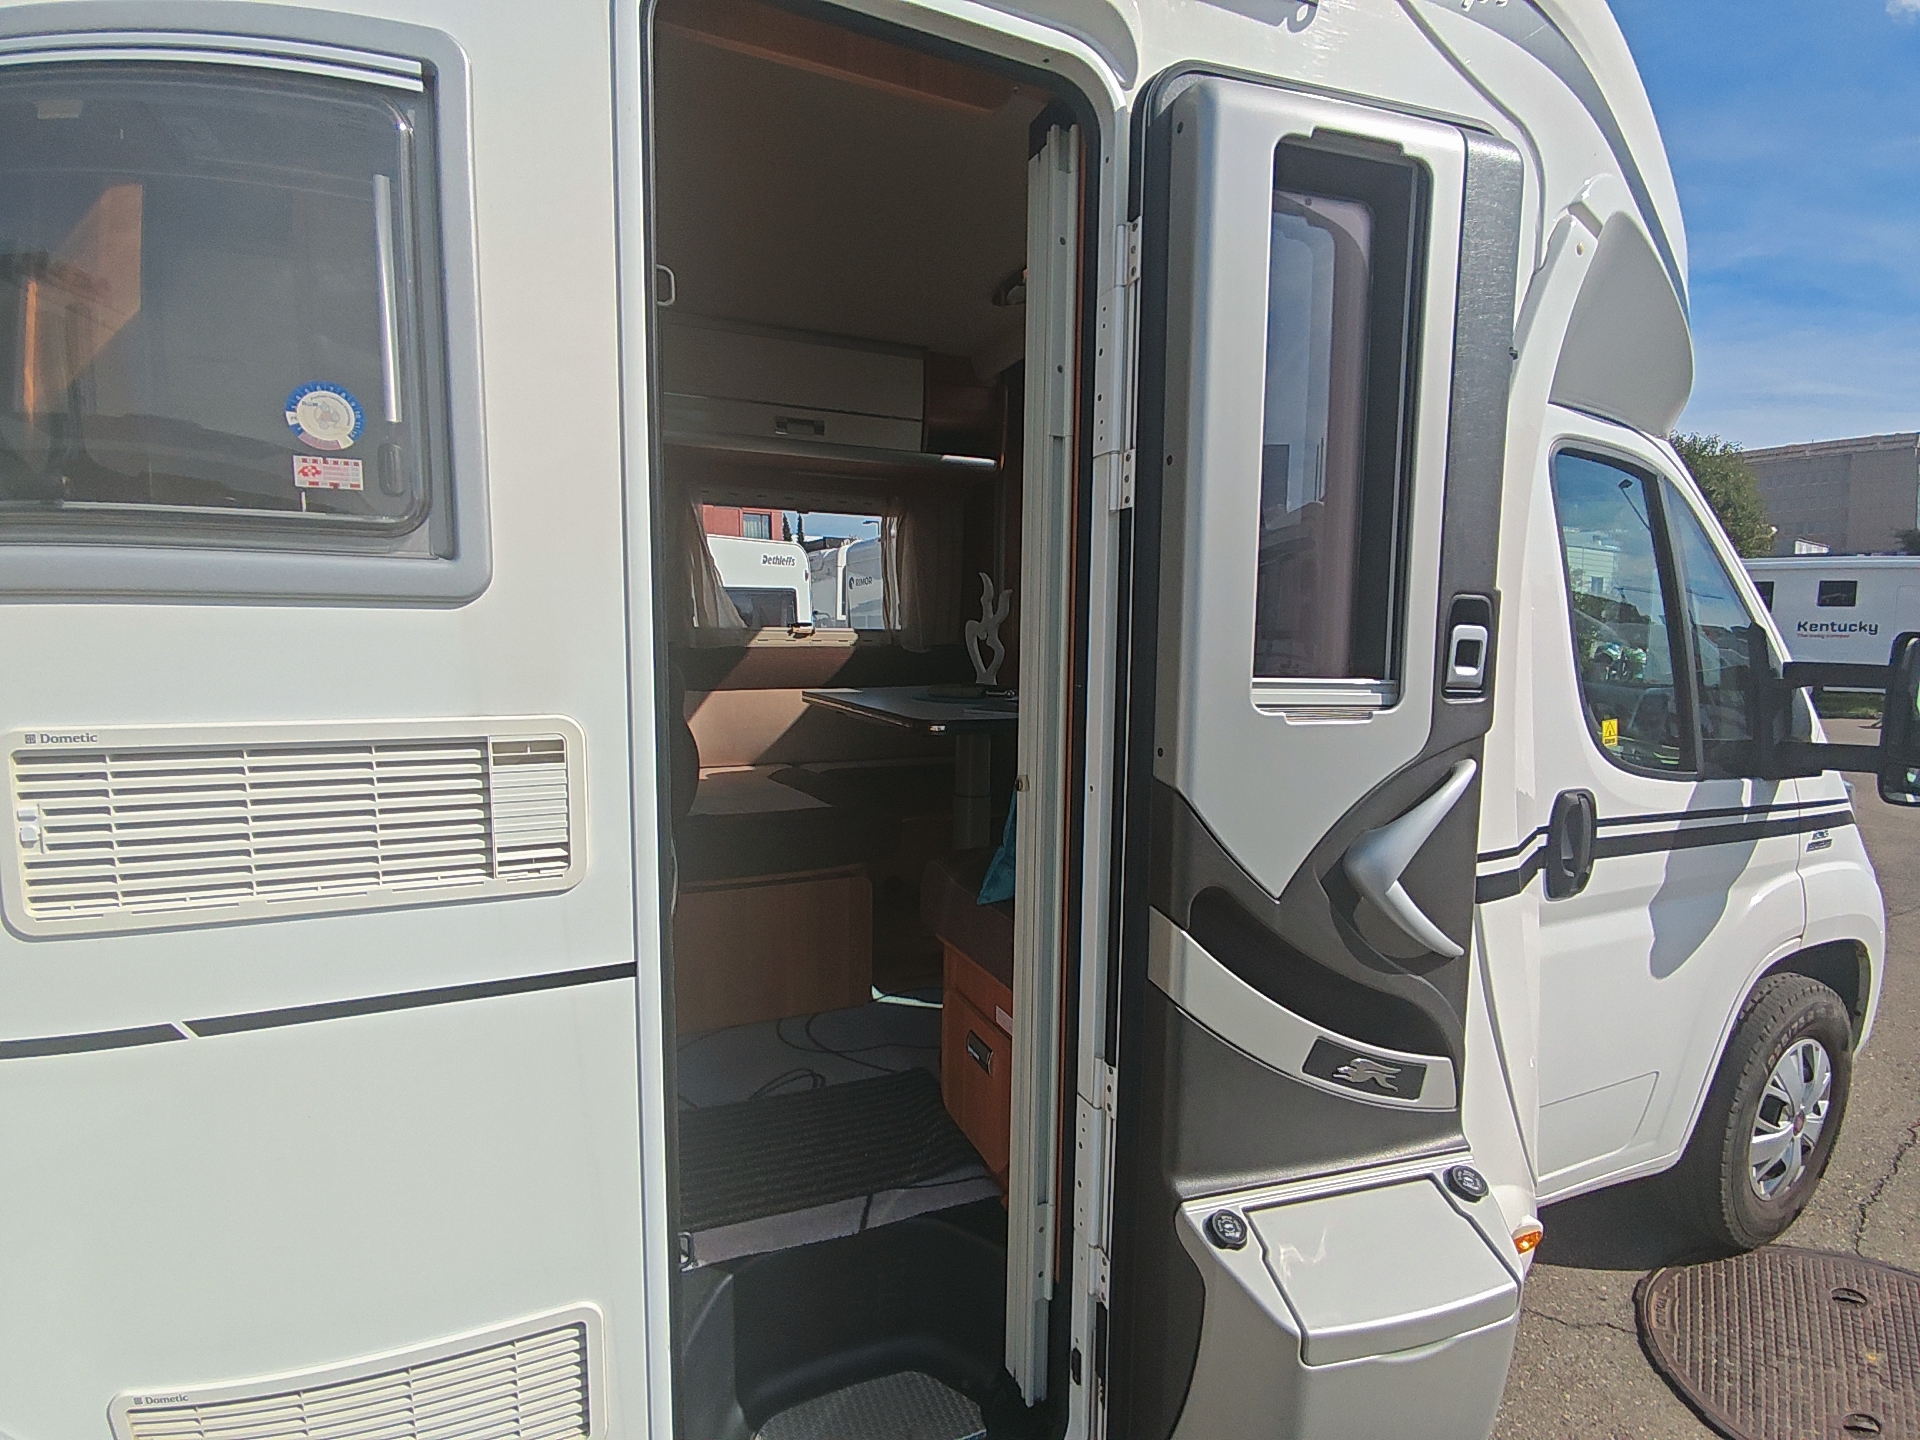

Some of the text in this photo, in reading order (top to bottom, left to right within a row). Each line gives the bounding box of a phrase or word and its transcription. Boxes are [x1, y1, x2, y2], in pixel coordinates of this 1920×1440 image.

[761, 554, 796, 567] Dethleffs
[1797, 620, 1879, 636] Kentucky
[40, 732, 98, 744] Dometic
[145, 1393, 189, 1405] Dometic
